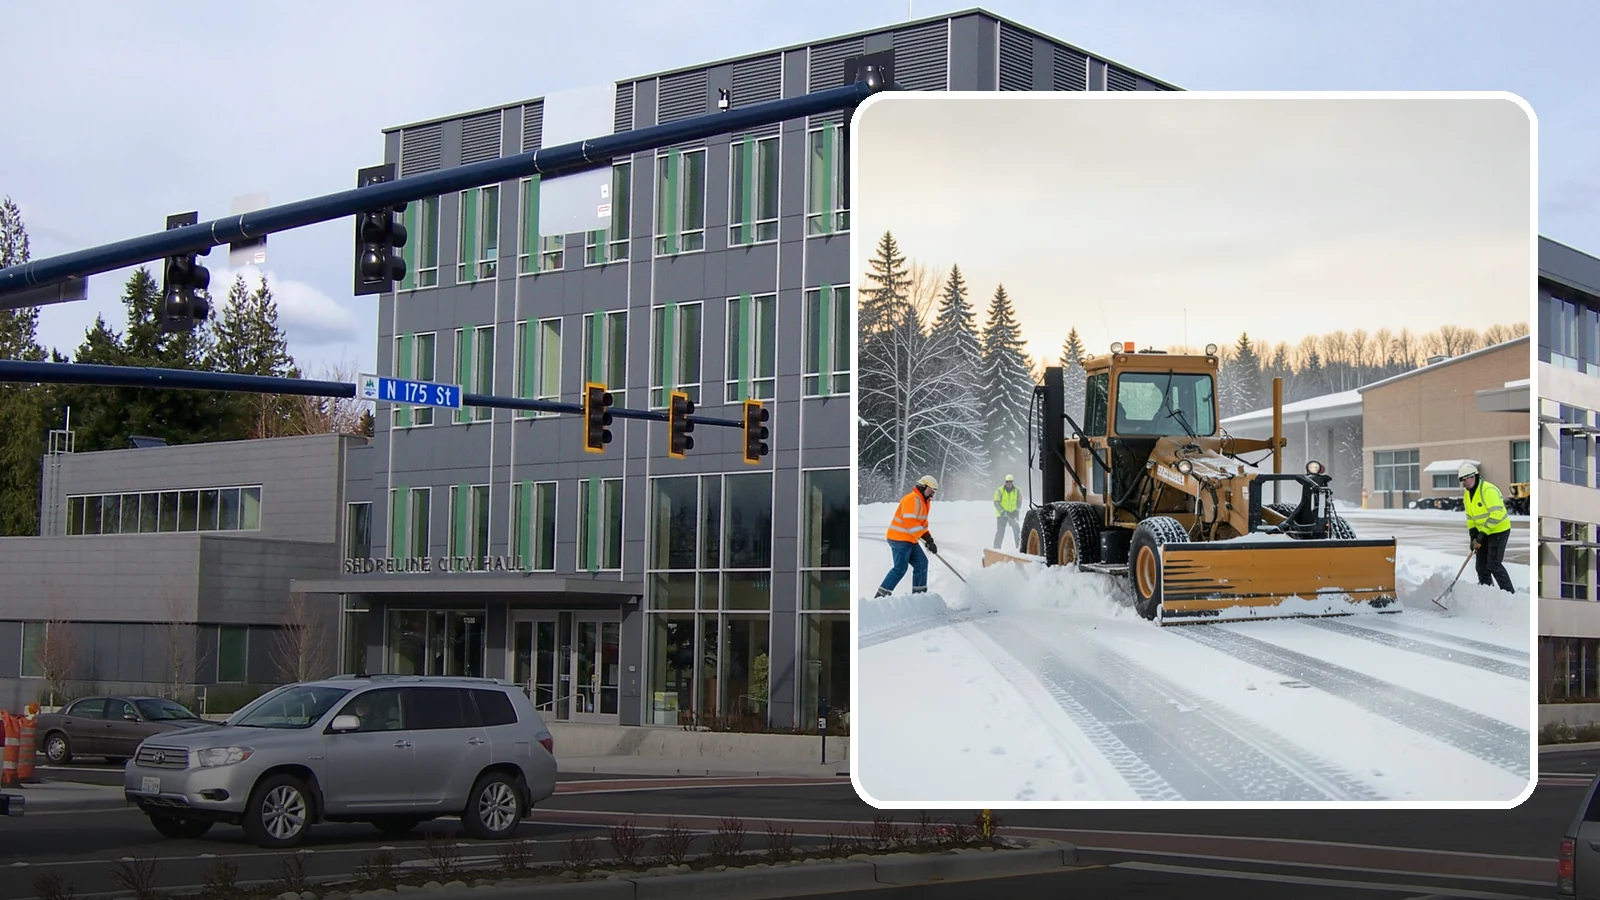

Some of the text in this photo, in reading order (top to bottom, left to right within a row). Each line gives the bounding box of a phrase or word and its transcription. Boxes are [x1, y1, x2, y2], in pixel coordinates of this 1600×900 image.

[387, 380, 451, 406] N 175 St
[344, 555, 525, 574] SHORELINE CITY HALL
